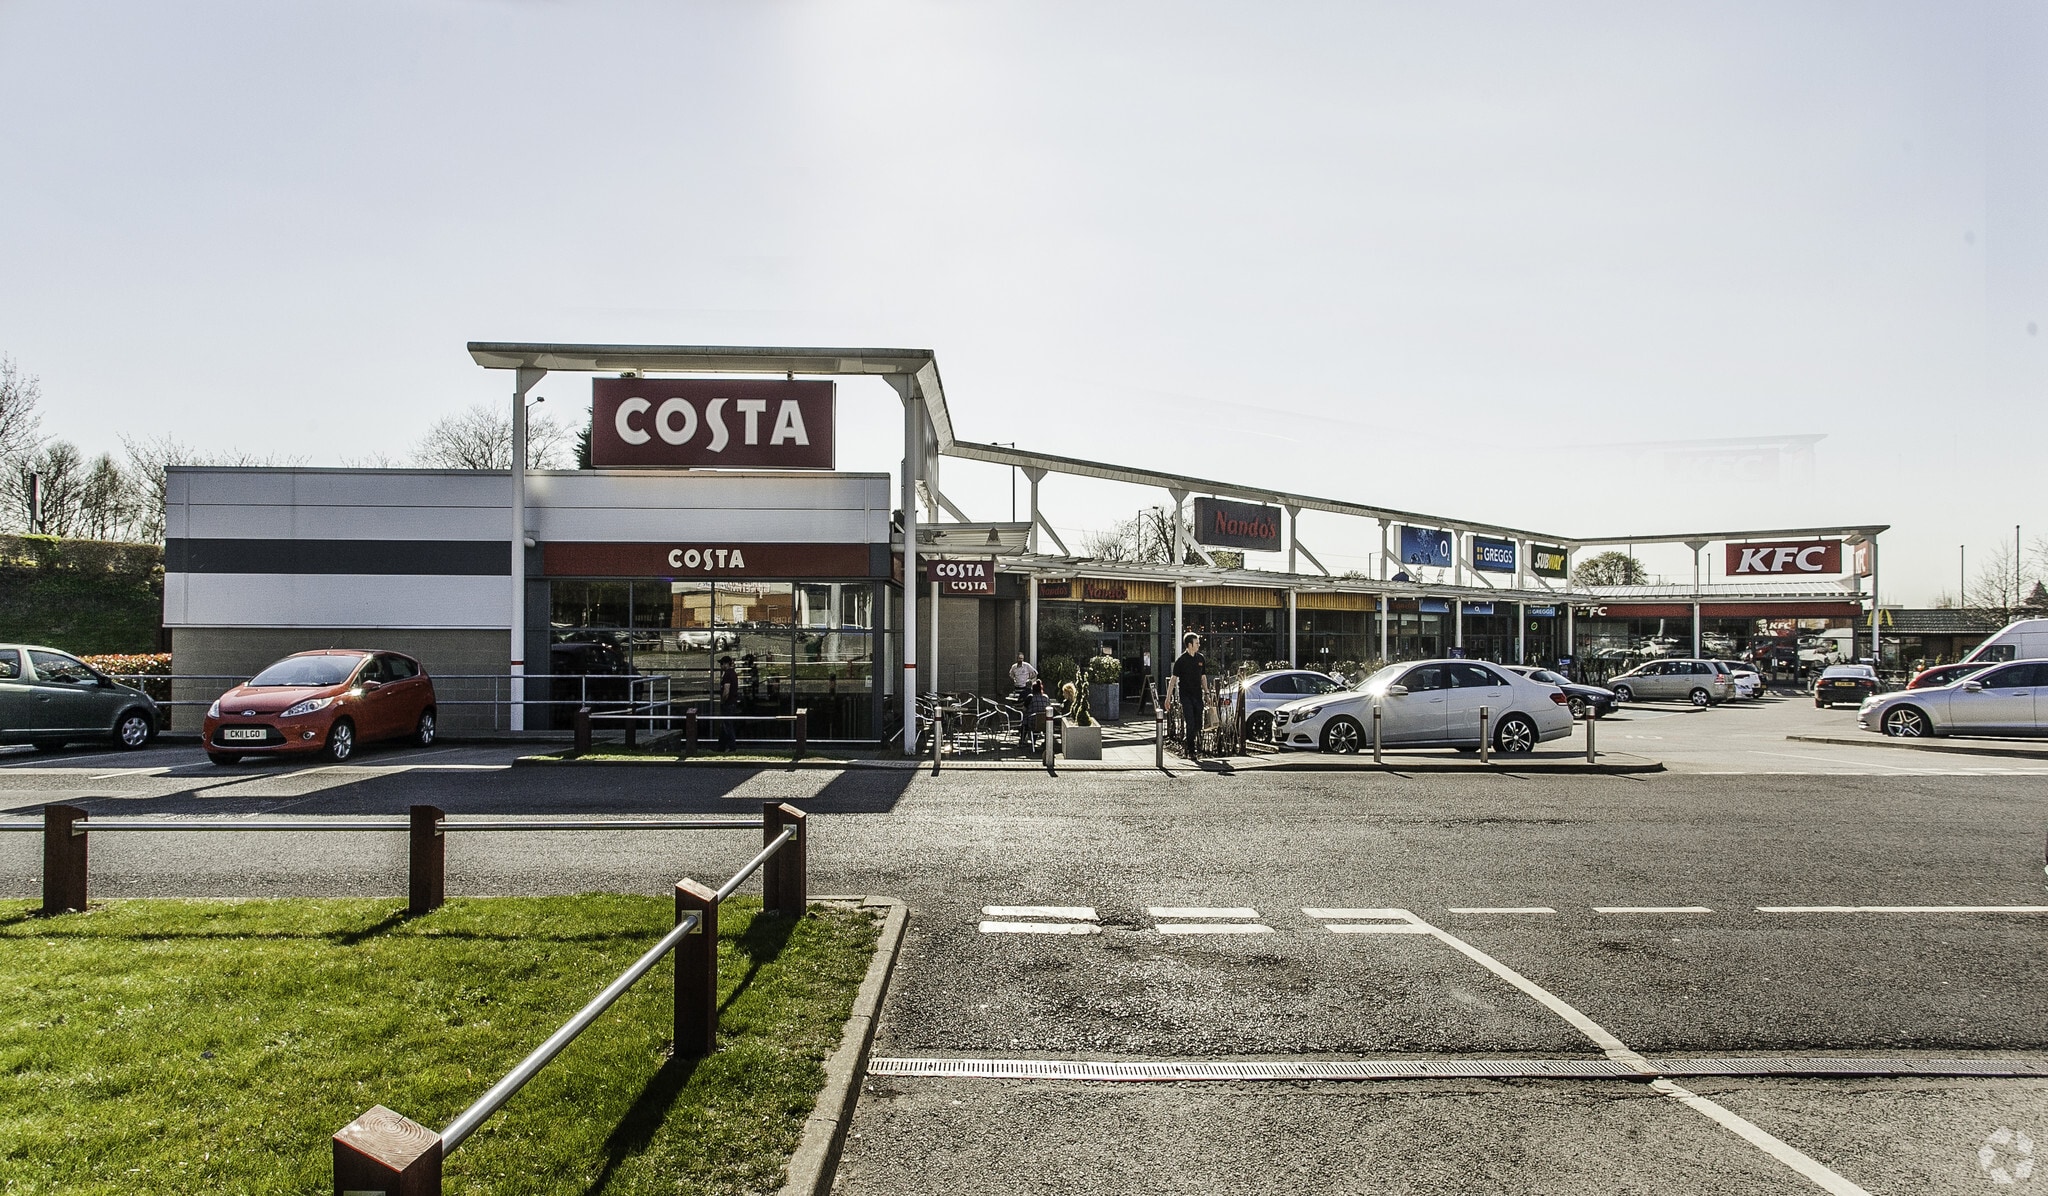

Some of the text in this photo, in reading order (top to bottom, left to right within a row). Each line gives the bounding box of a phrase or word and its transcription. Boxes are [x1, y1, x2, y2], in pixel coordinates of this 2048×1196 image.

[615, 397, 810, 453] COSTA
[1215, 510, 1277, 538] Nando's
[668, 548, 745, 571] COSTA
[1483, 547, 1513, 564] GREGGS
[1535, 552, 1565, 571] SUBWAY
[1736, 546, 1826, 573] KFC
[936, 563, 985, 578] COSTA
[951, 581, 988, 591] COSTA
[1086, 582, 1128, 599] Nando's
[1769, 622, 1792, 630] KFC
